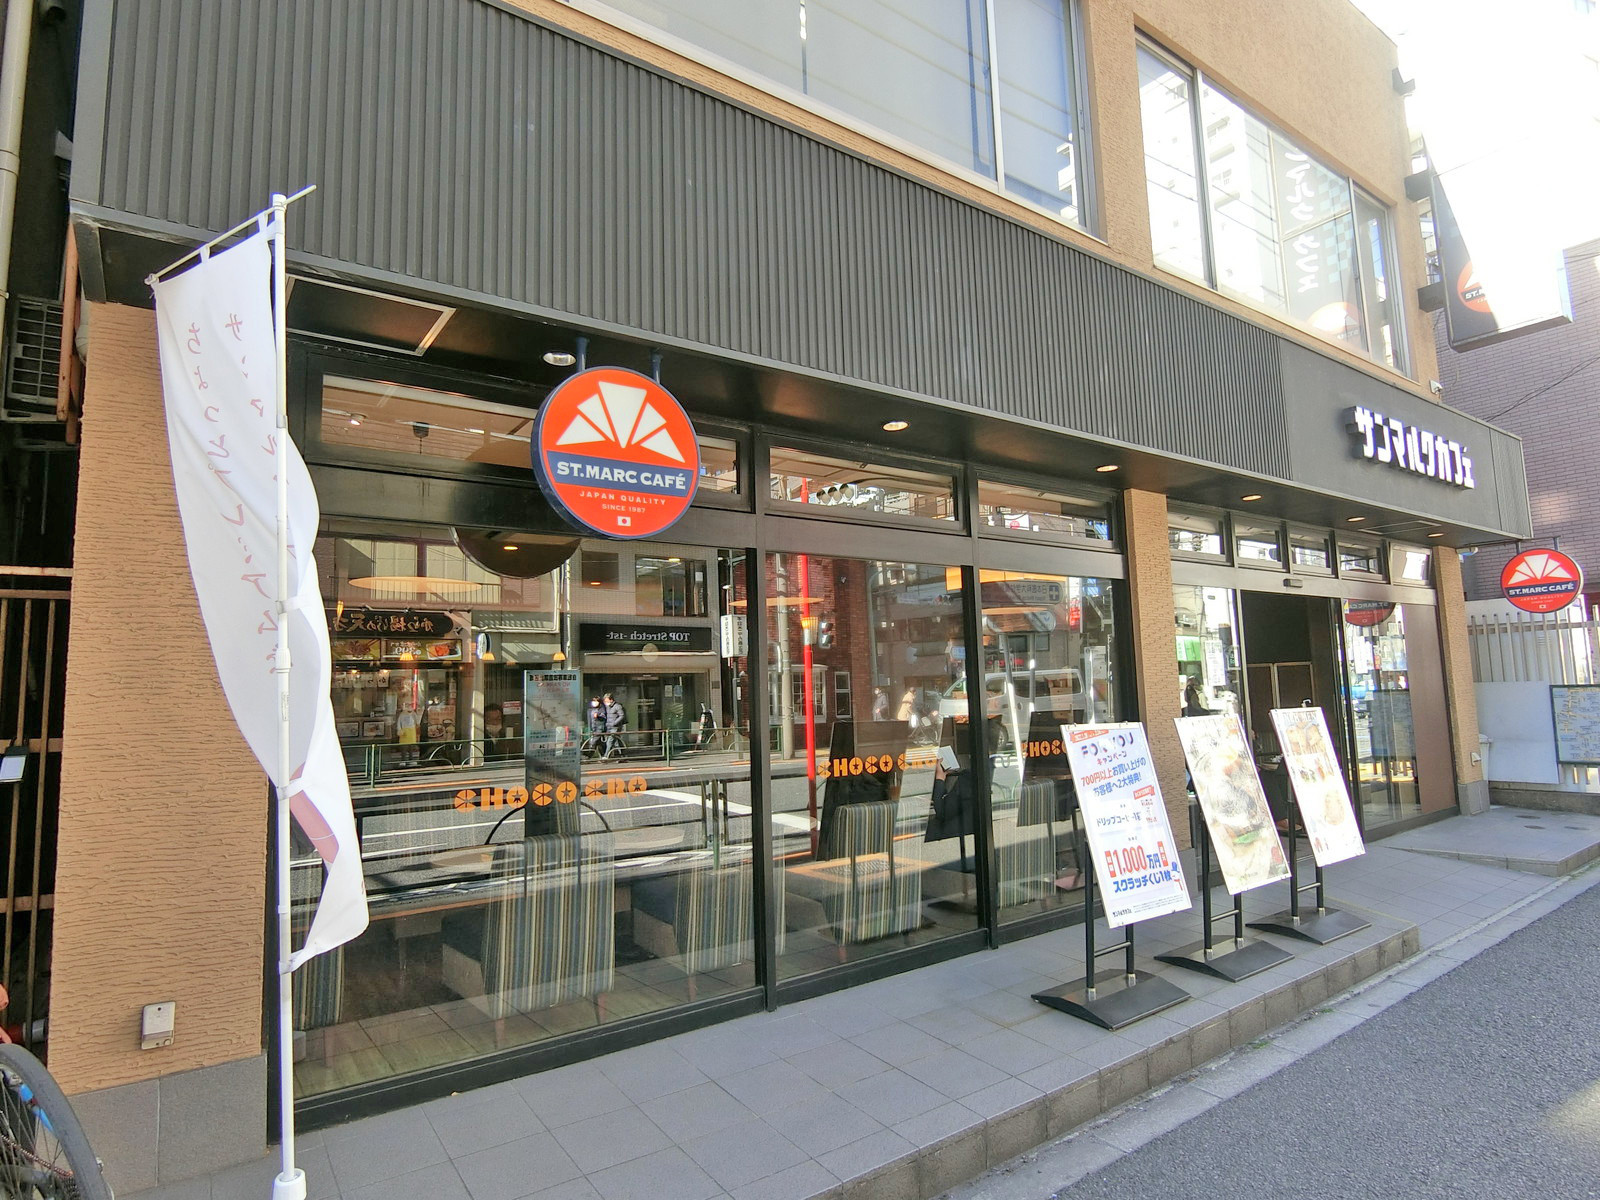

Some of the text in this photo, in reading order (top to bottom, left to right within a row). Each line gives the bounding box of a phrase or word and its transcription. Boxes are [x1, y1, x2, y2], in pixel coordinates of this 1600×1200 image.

[1354, 406, 1475, 489] サンマルクカフェ
[557, 461, 686, 490] ST.MARC CAFÉ
[580, 490, 666, 505] JAPAN QUALITY
[602, 503, 646, 513] SINCE 1987
[1509, 582, 1574, 595] ST.MARC CAFÉ
[817, 754, 894, 779] CHOCO
[1097, 751, 1127, 765] キャンペーン
[1081, 757, 1146, 787] 700円以上お買い上げの
[454, 776, 647, 813] CHOCO CRO
